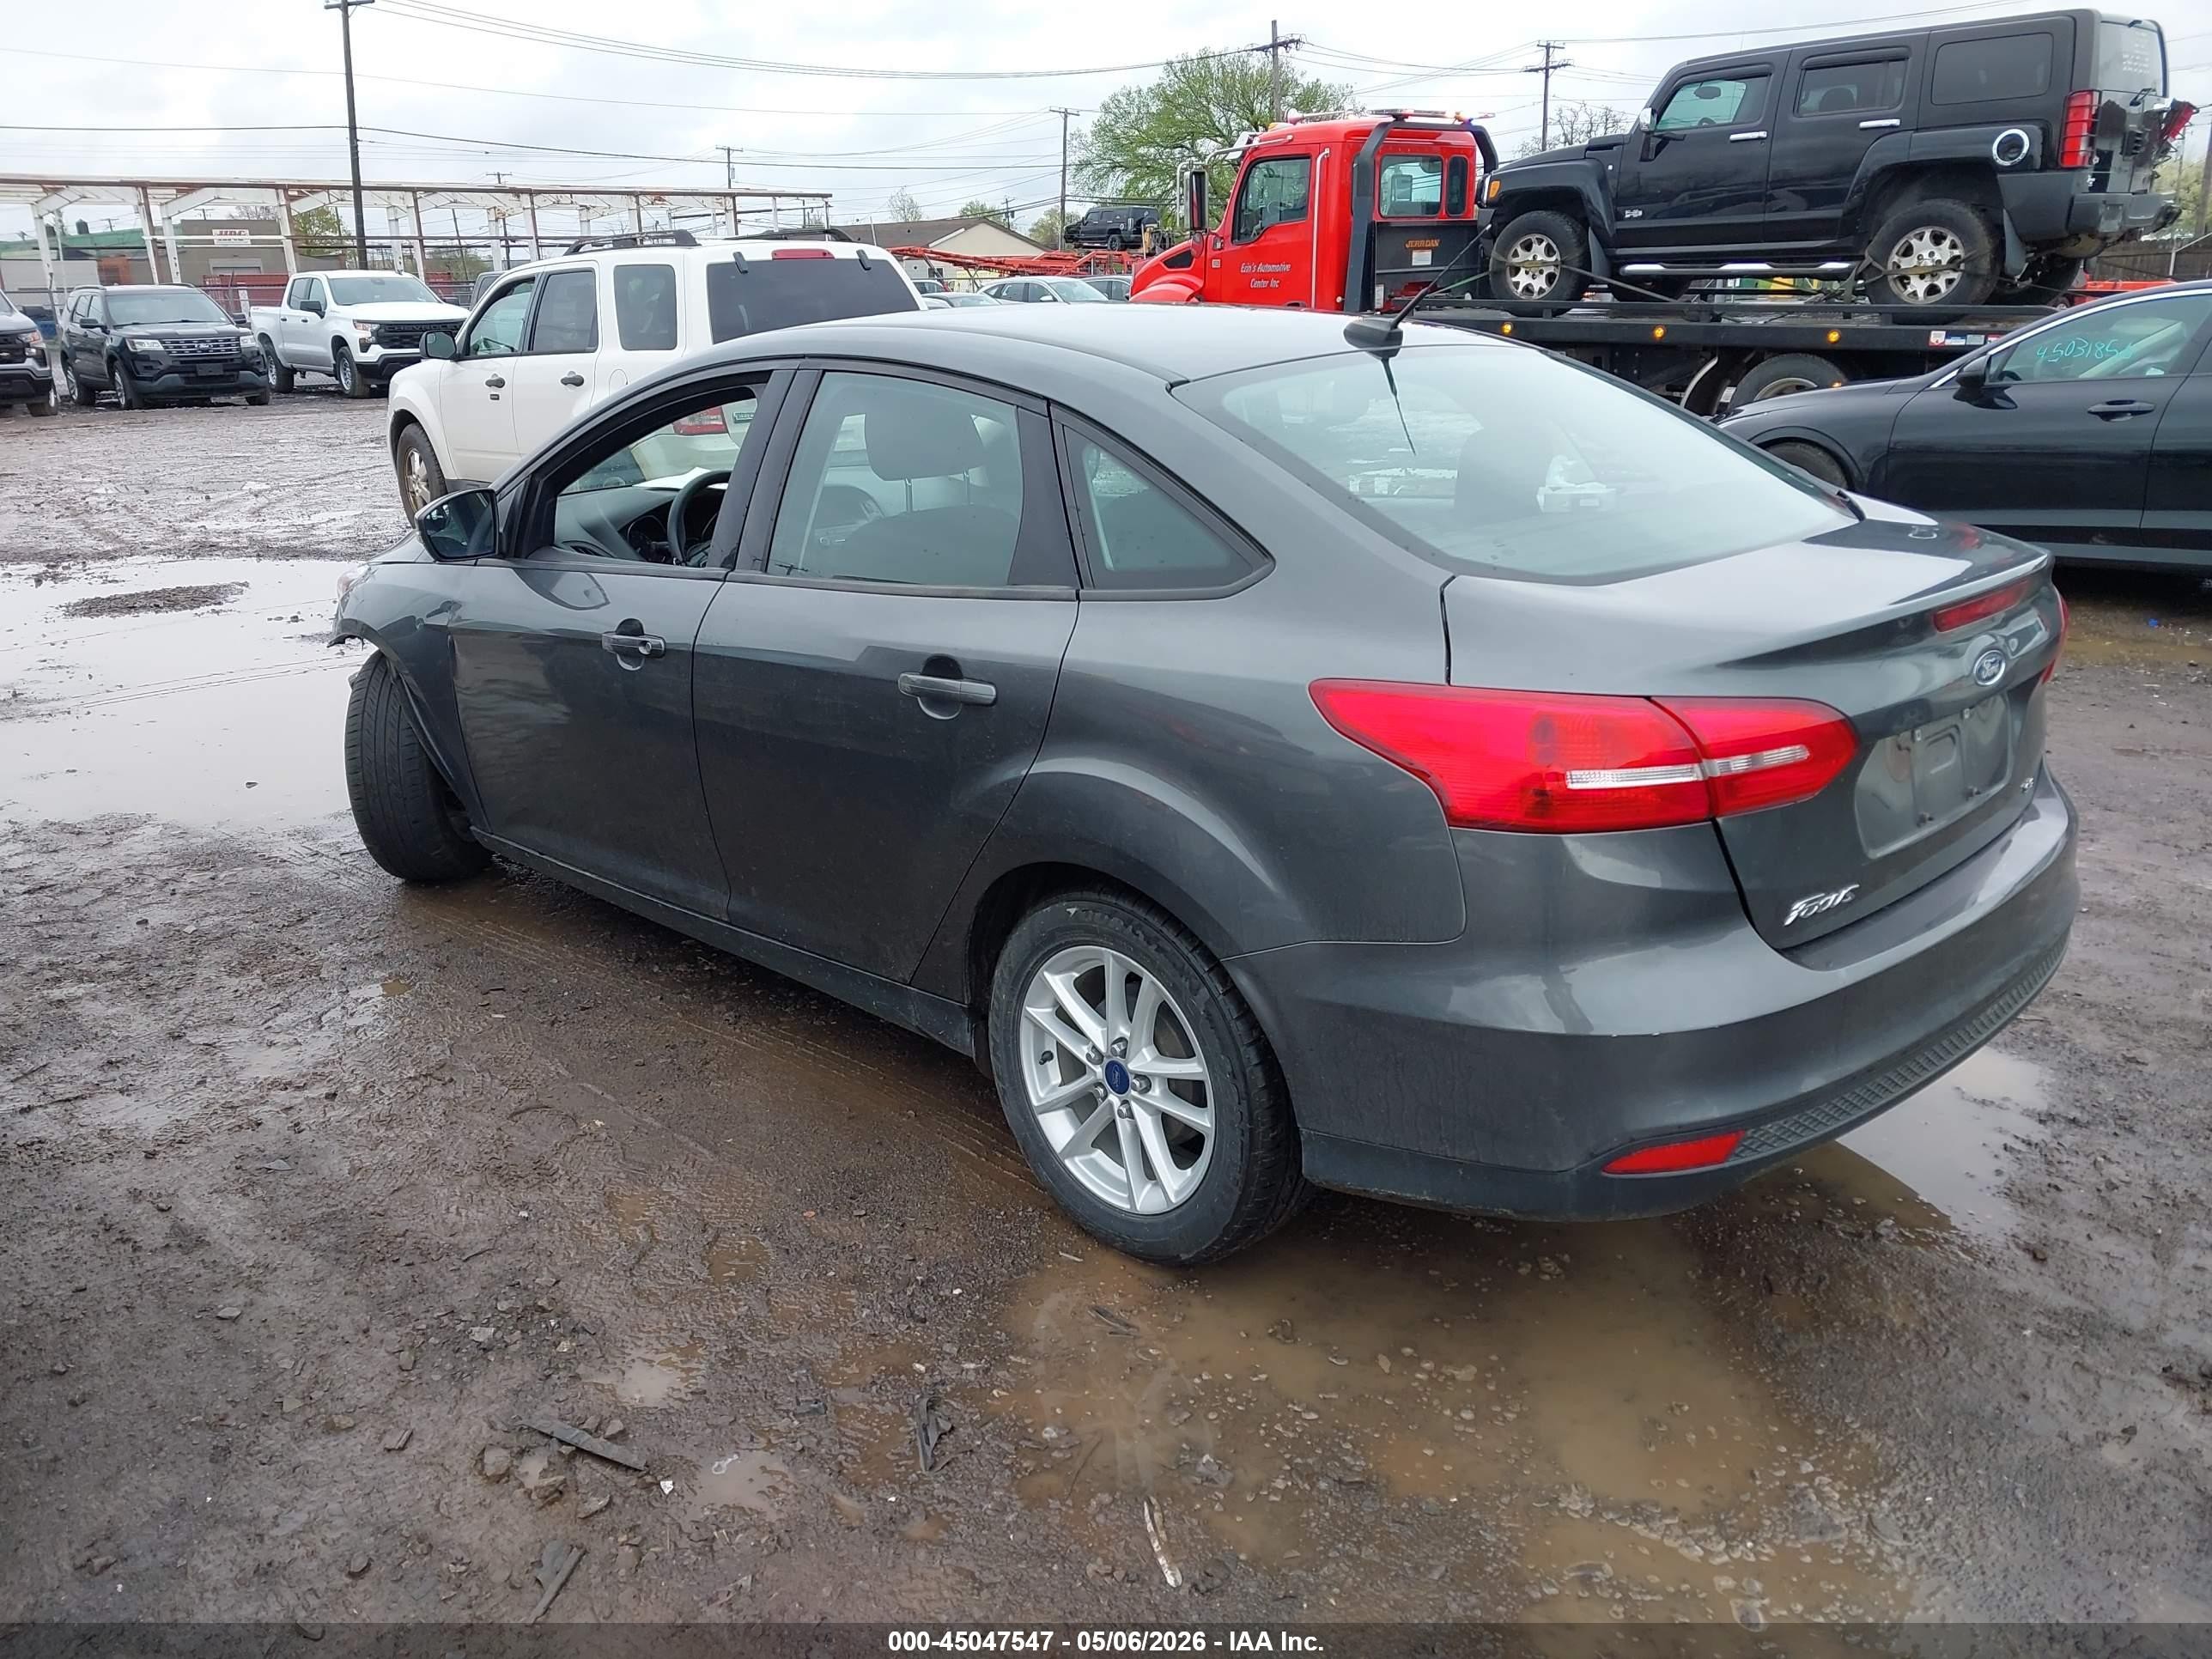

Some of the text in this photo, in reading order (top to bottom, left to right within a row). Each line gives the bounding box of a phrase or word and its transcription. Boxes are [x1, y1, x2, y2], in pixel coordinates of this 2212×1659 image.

[1257, 261, 1291, 273] Automotive
[1250, 277, 1280, 289] Center Inc
